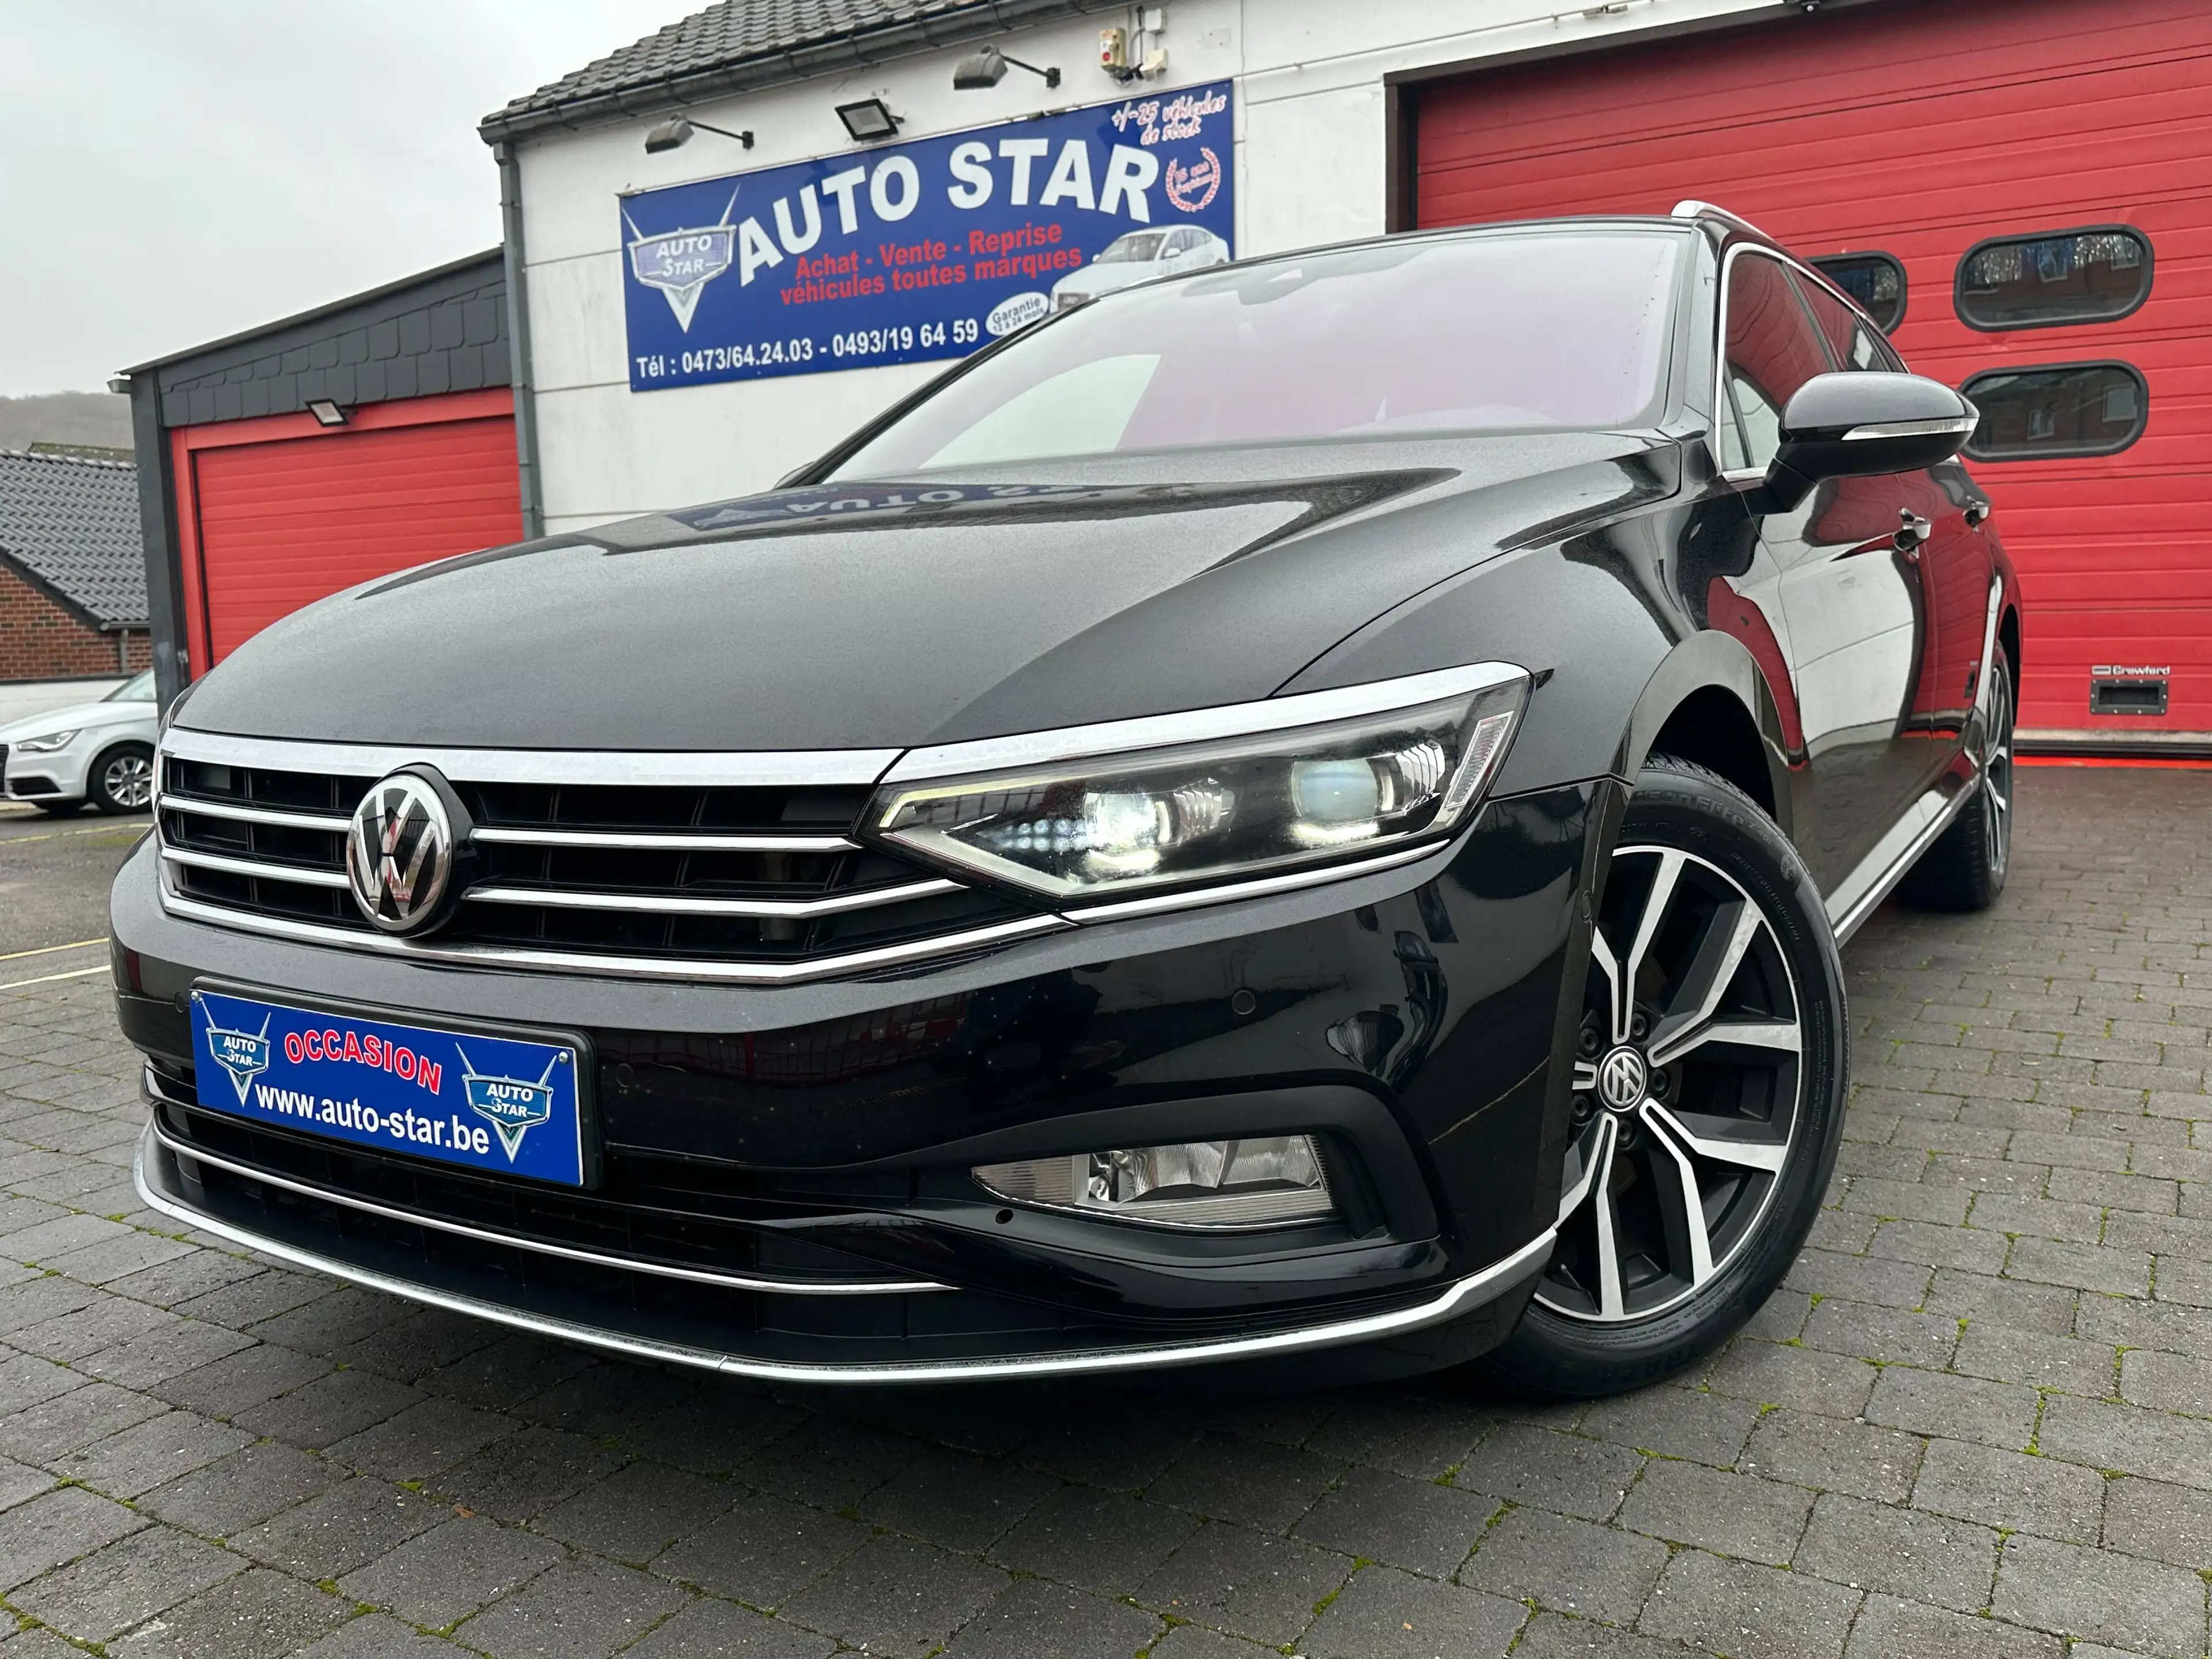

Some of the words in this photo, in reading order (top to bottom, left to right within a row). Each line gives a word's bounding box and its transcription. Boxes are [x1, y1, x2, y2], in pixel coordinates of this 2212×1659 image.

[738, 154, 920, 287] AUTO
[947, 138, 1159, 224] STAR
[656, 235, 712, 258] AUTO
[795, 250, 858, 279] Achat
[880, 238, 946, 266] Vente
[969, 222, 1063, 257] Reprise
[662, 257, 704, 277] STAR
[781, 275, 885, 304] véhicules
[893, 263, 966, 290] toutes
[974, 247, 1082, 280] marques
[992, 297, 1041, 325] Garantie
[637, 357, 665, 378] Tél
[681, 338, 814, 373] 0473/64.24.03
[832, 325, 912, 358] 0493/19
[920, 322, 946, 347] 64
[952, 318, 978, 343] 59
[223, 1035, 256, 1054] AUTO
[226, 1049, 253, 1068] STAR
[284, 1029, 442, 1096] OCCASION
[486, 1083, 533, 1103] AUTO
[255, 1084, 491, 1155] www.auto-star.be
[491, 1099, 528, 1118] STAR
